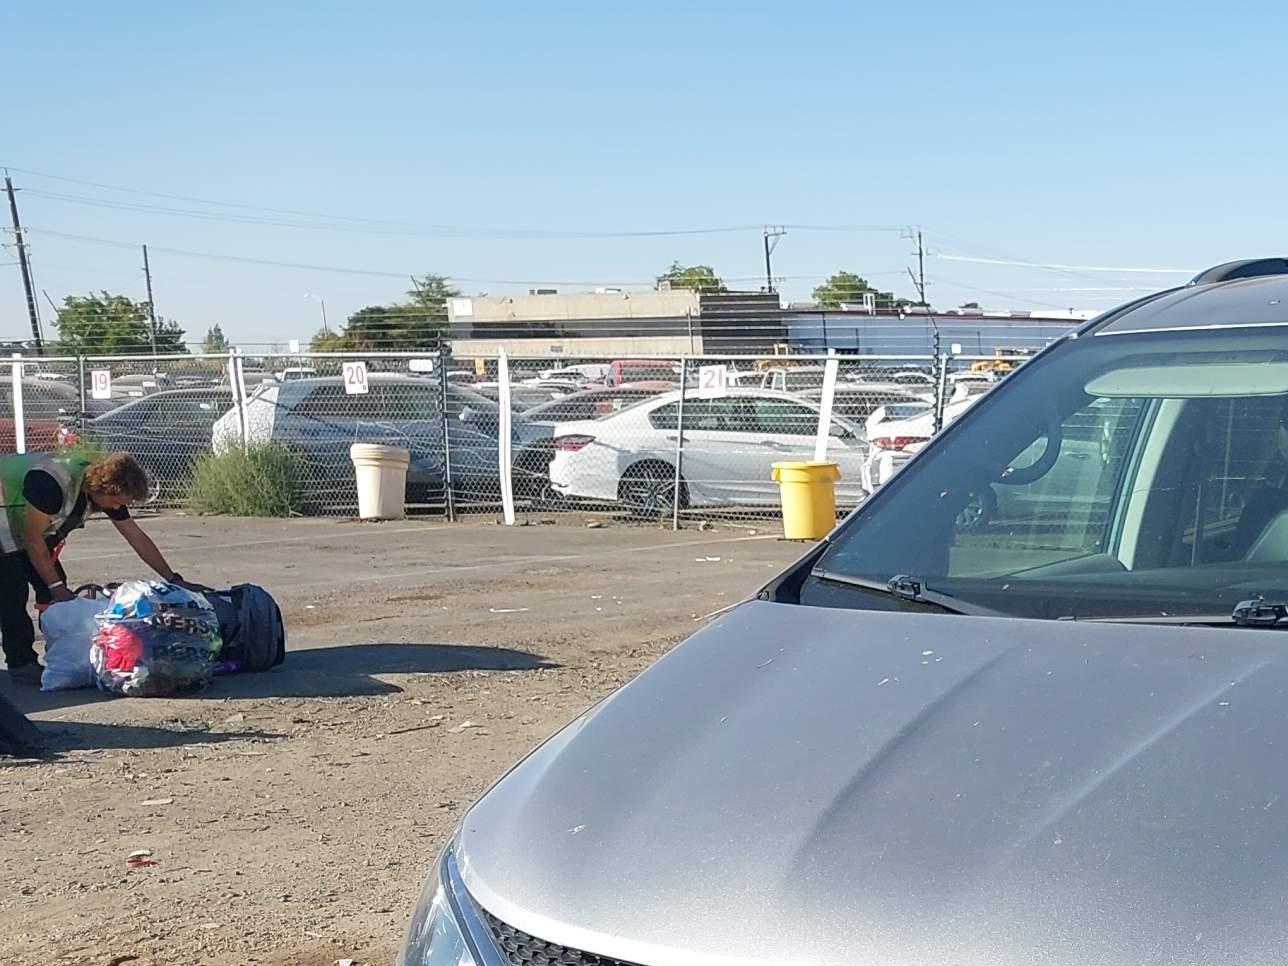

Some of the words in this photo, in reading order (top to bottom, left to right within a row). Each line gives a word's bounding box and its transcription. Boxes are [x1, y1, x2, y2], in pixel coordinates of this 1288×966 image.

[94, 373, 108, 391] 19
[346, 365, 364, 385] 20
[703, 368, 723, 389] 21
